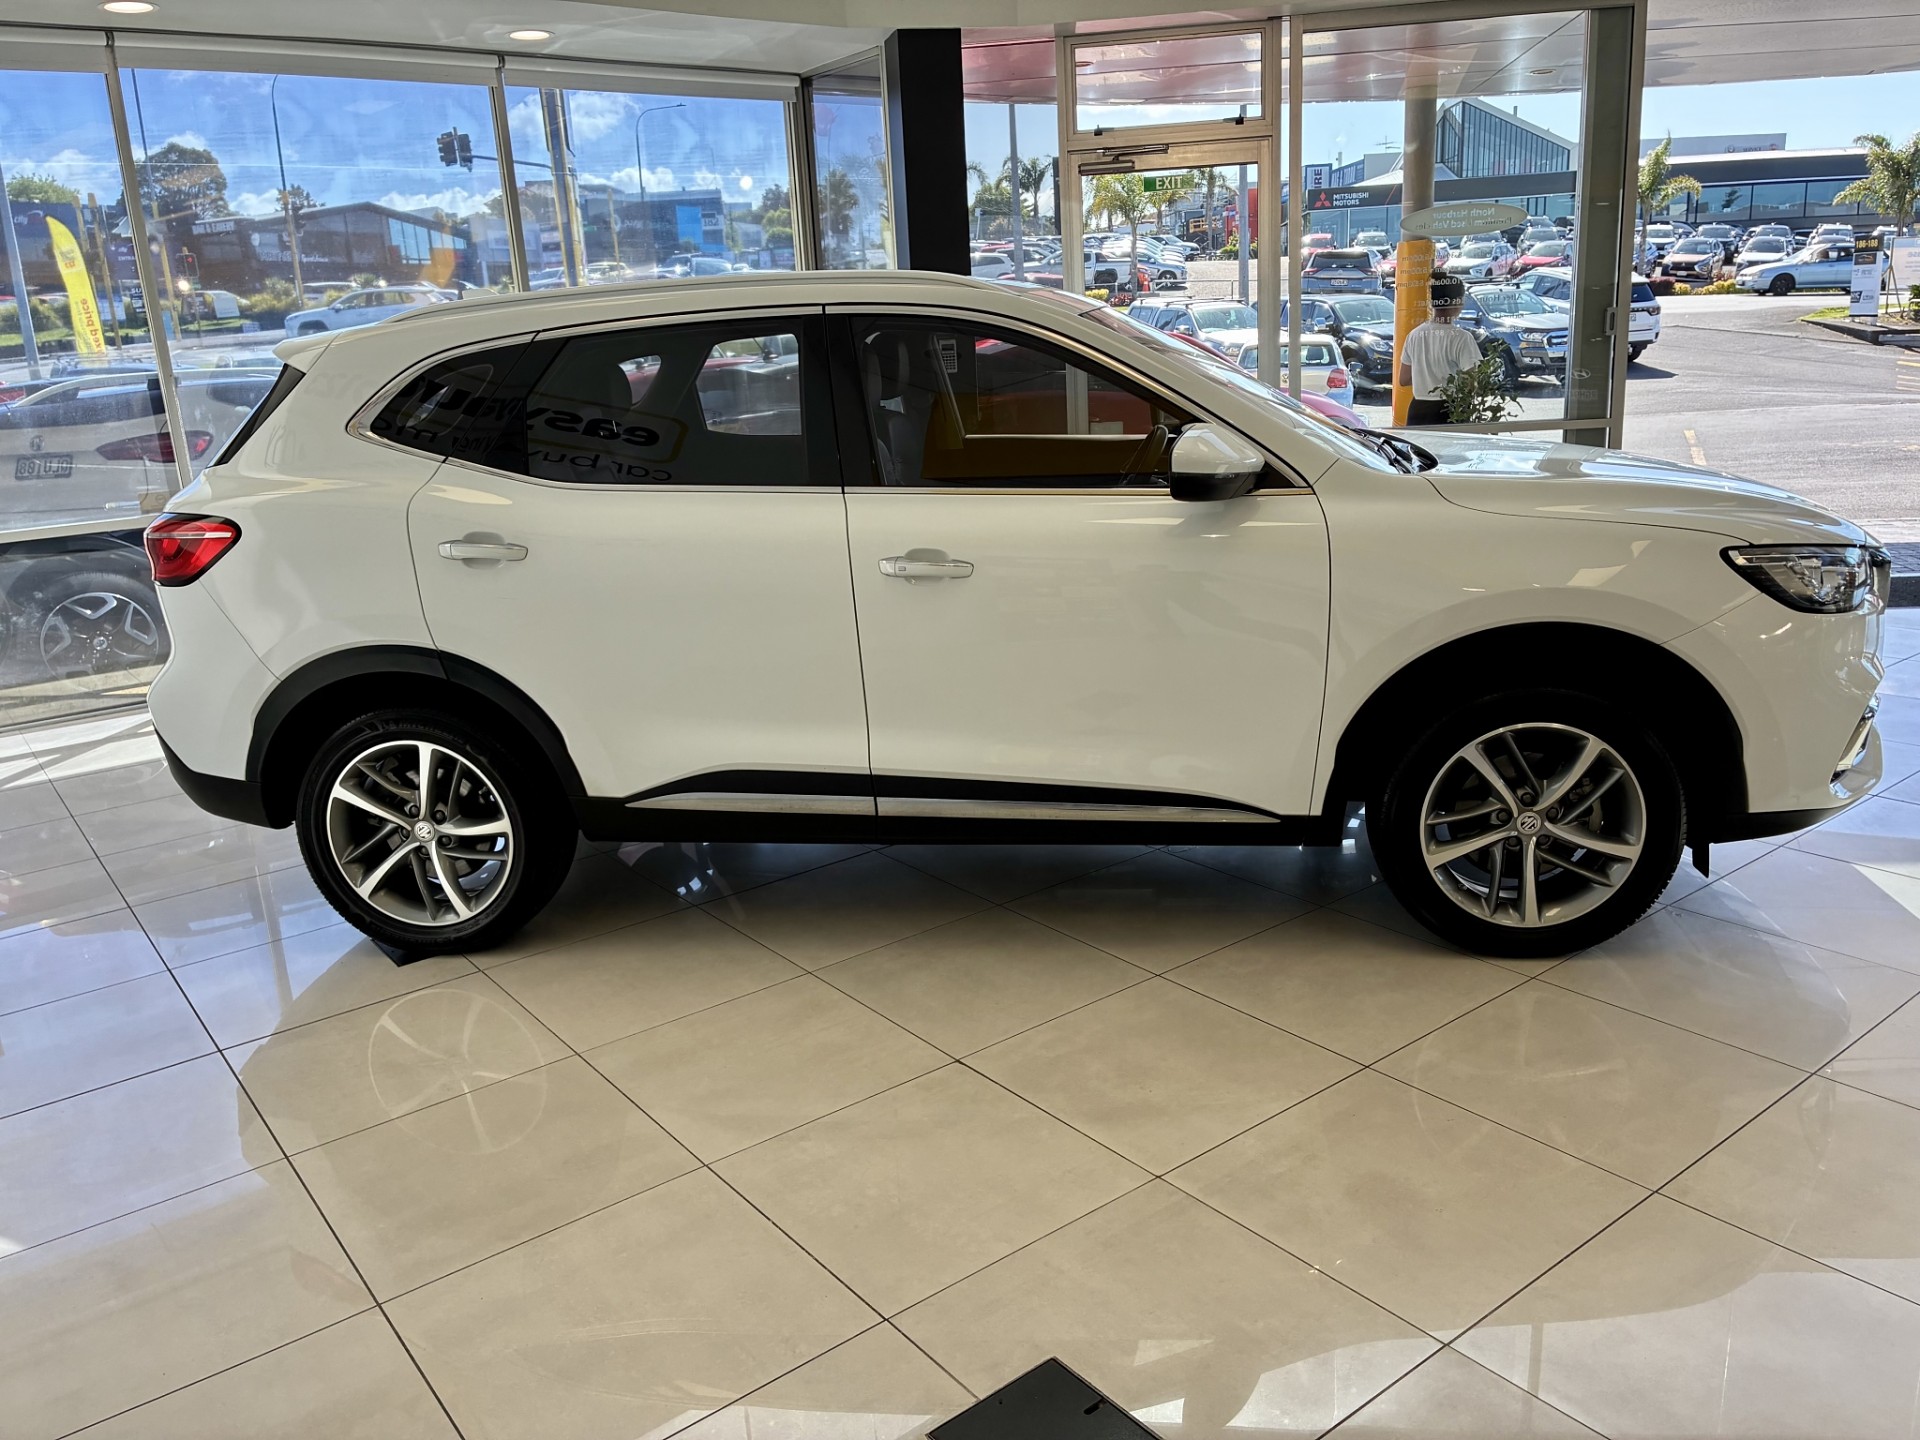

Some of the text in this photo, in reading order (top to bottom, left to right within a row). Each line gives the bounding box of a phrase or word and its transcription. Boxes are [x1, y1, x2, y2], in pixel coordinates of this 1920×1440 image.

[1156, 176, 1183, 189] EXIT
[1333, 192, 1369, 201] MITSUBISHI
[1333, 199, 1360, 207] MOTORS
